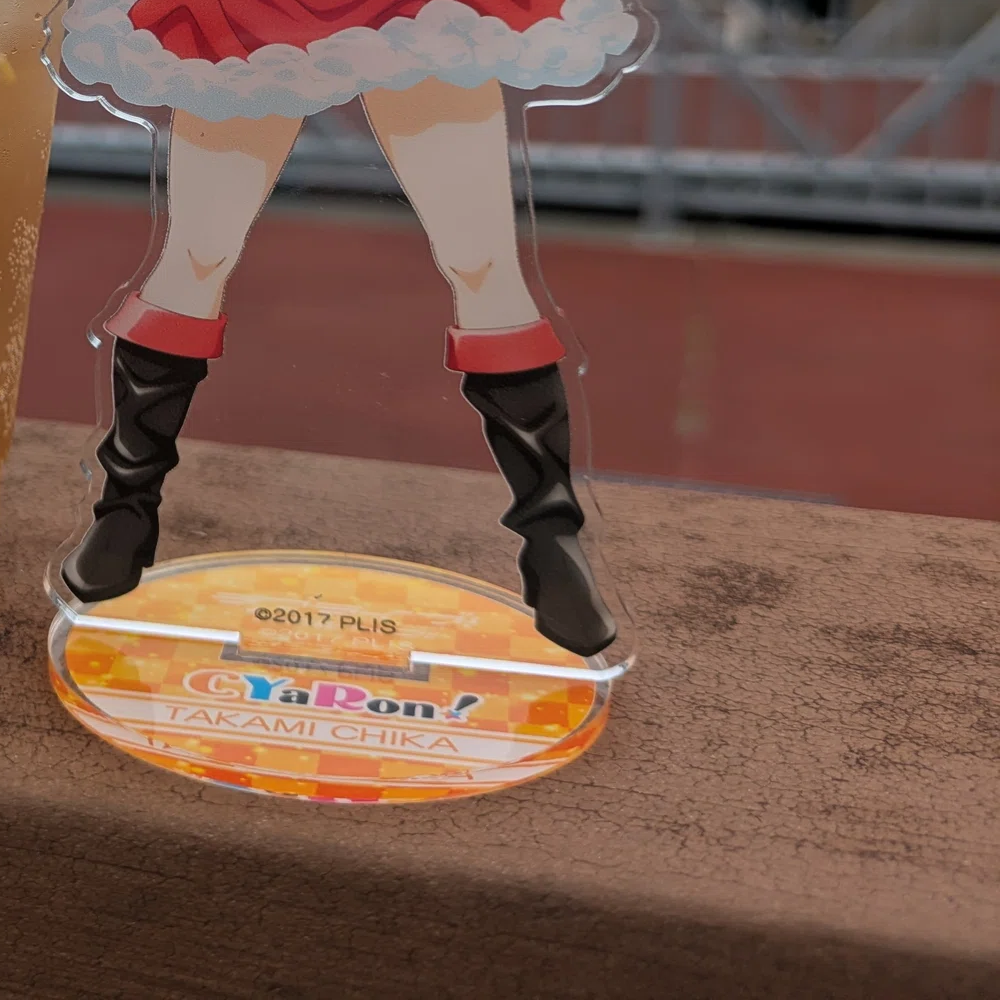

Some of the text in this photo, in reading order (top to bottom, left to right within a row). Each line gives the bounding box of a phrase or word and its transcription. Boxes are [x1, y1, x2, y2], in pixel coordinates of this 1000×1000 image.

[339, 615, 397, 635] PLIS
[166, 704, 461, 754] TAKAMI CHIKA
